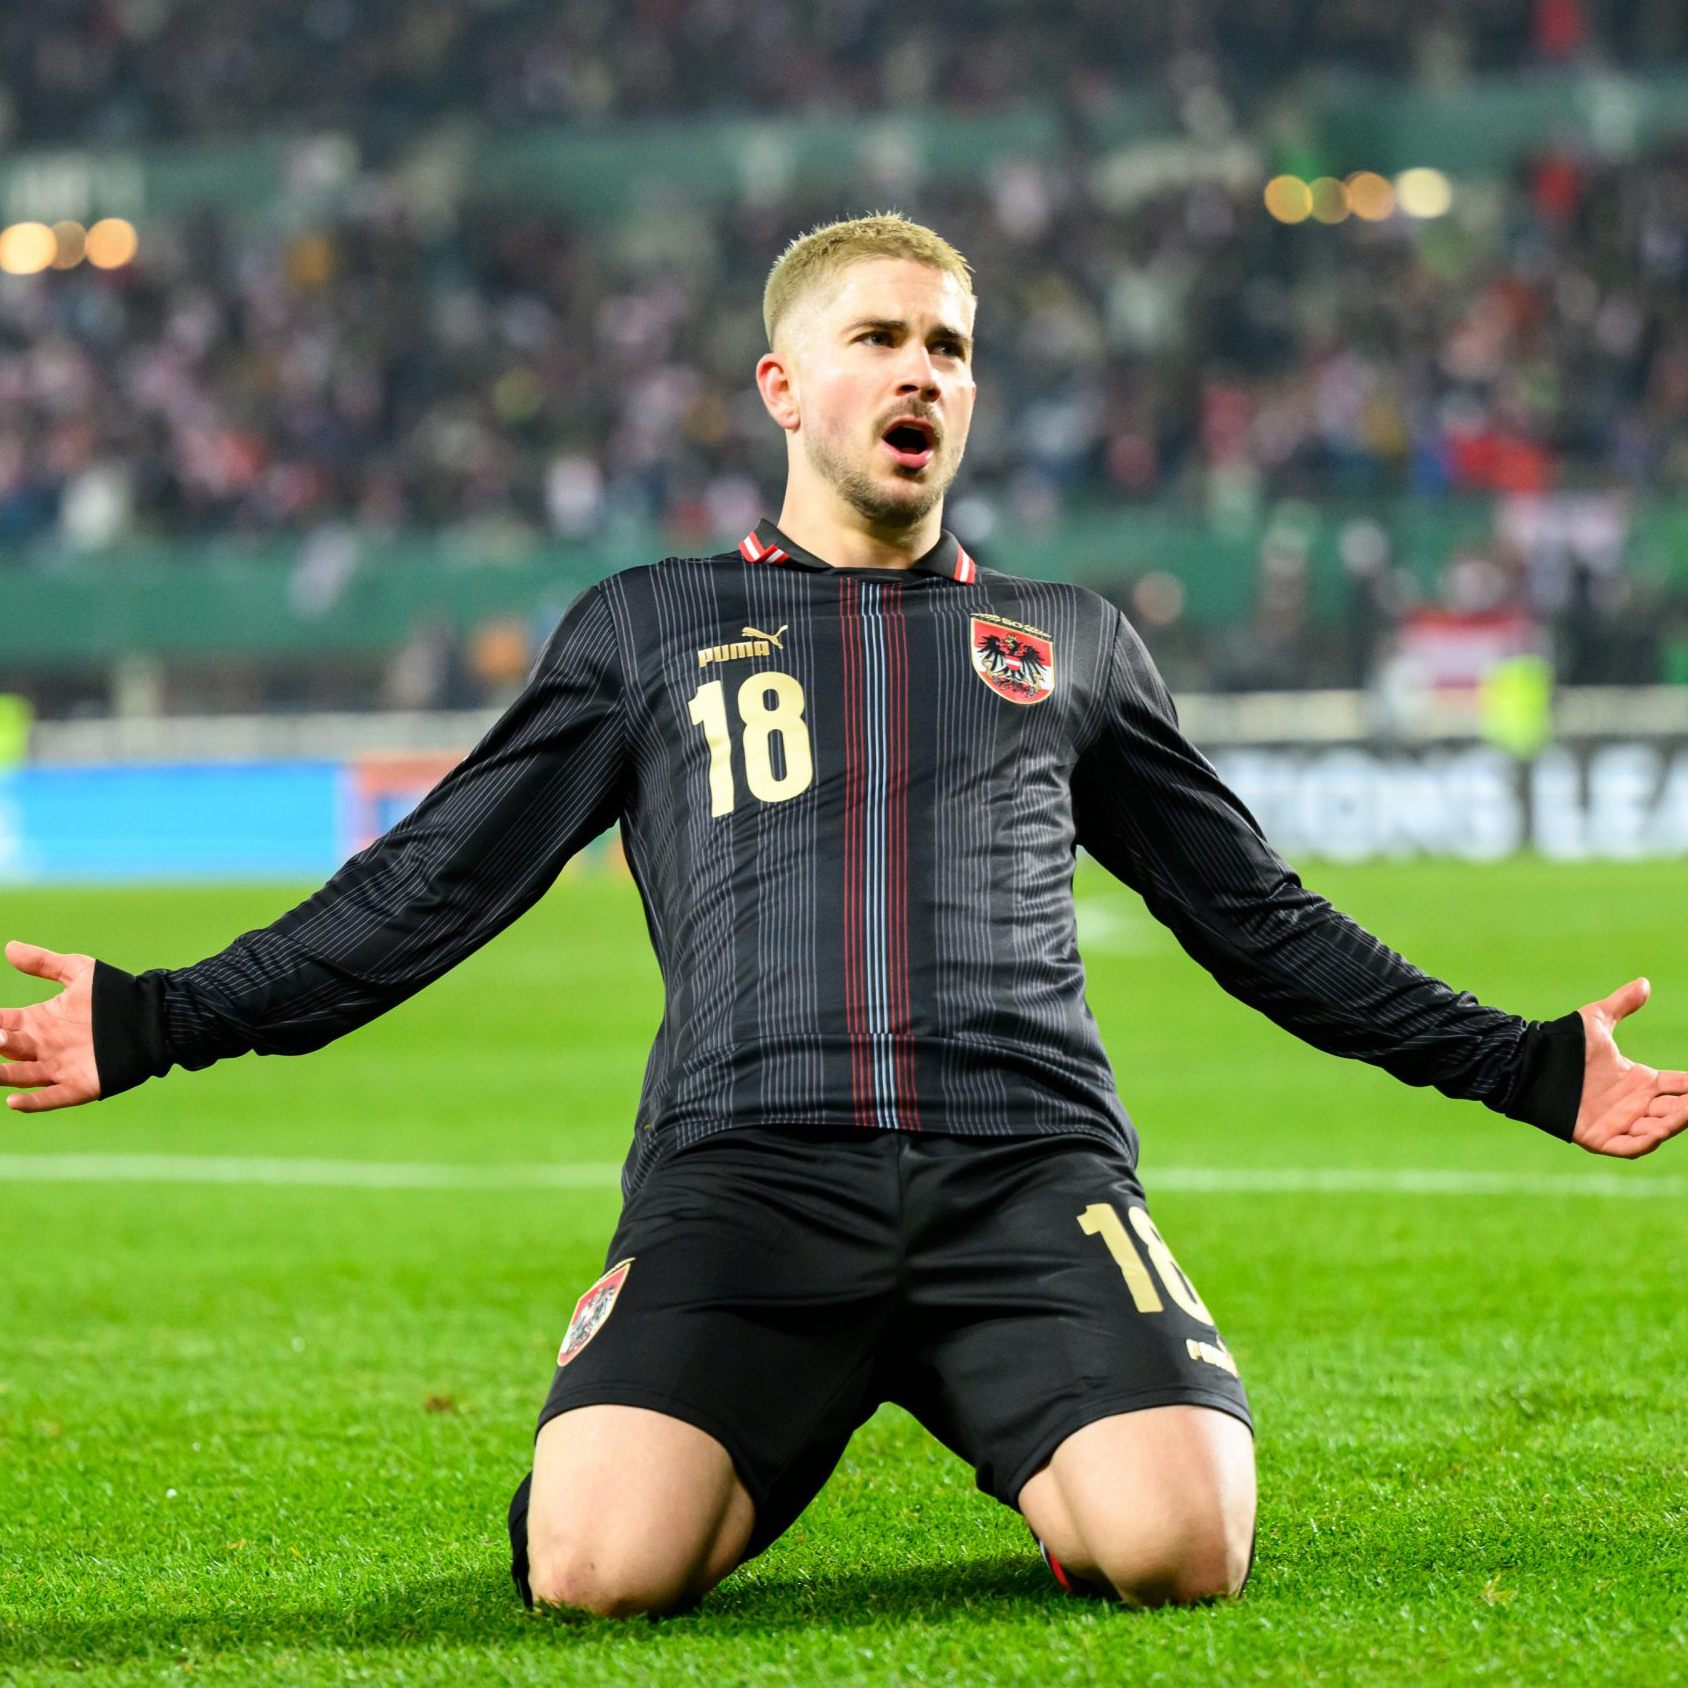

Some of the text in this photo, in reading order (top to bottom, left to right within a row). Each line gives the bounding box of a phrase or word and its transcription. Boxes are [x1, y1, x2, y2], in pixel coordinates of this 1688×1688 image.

[698, 641, 770, 667] PUMA
[688, 671, 813, 818] 18
[1076, 1203, 1216, 1326] 18
